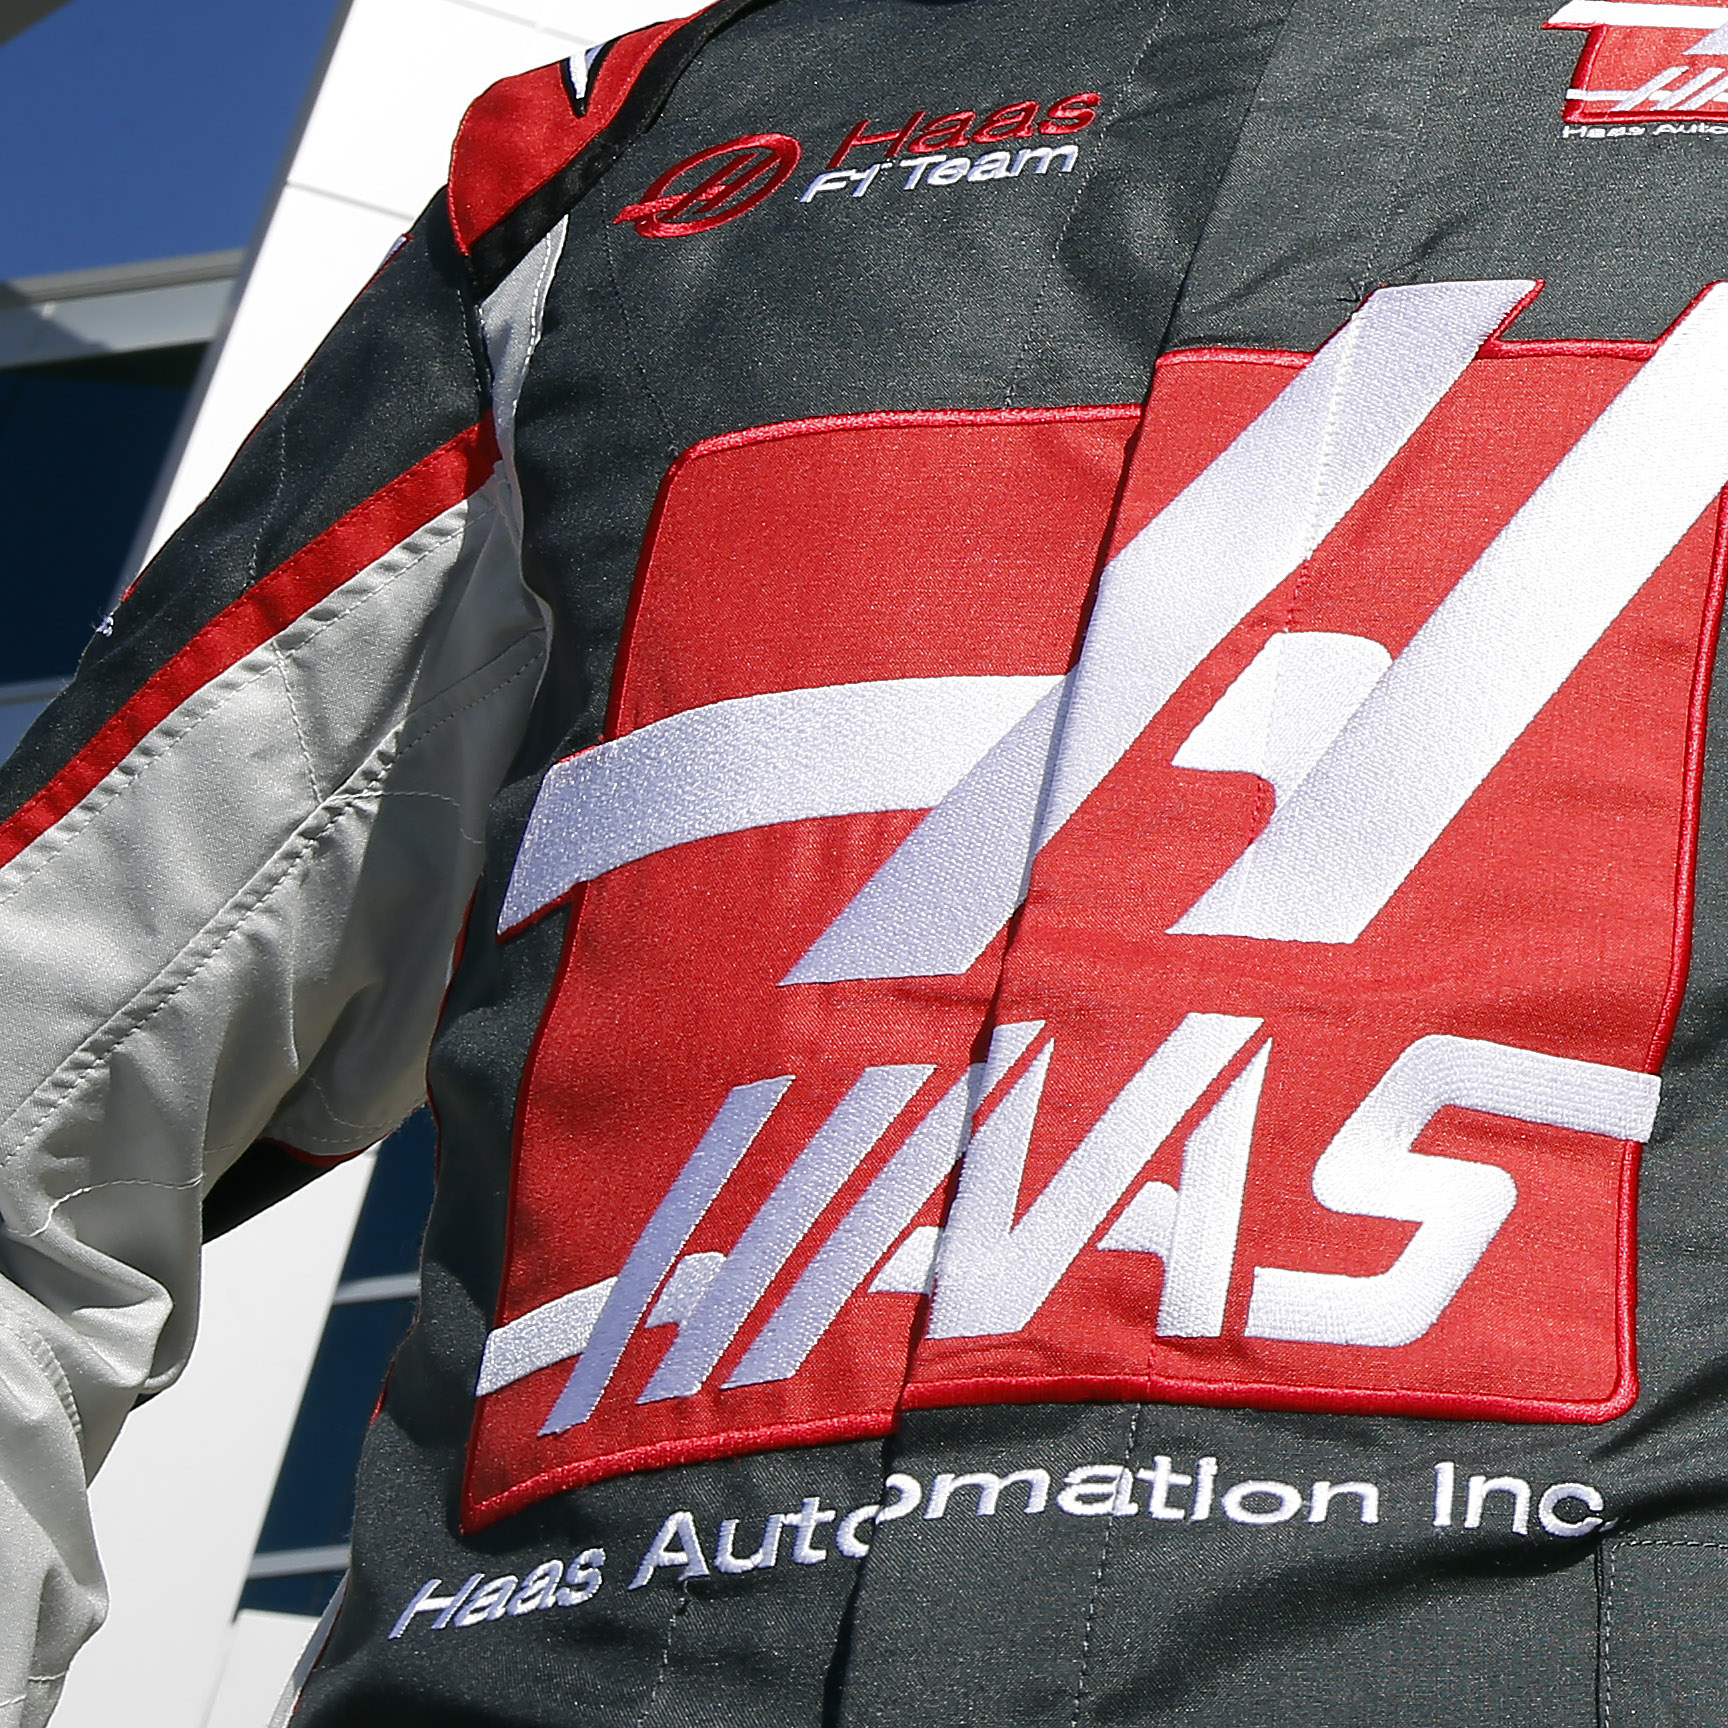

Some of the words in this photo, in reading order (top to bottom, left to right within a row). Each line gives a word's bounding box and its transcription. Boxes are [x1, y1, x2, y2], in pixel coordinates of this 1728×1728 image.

[826, 92, 1102, 168] Haas
[900, 144, 1079, 191] Team
[1562, 124, 1645, 139] Haas
[476, 1011, 1662, 1436] HAAS
[388, 1547, 606, 1639] Haas
[627, 1455, 1380, 1591] Automation
